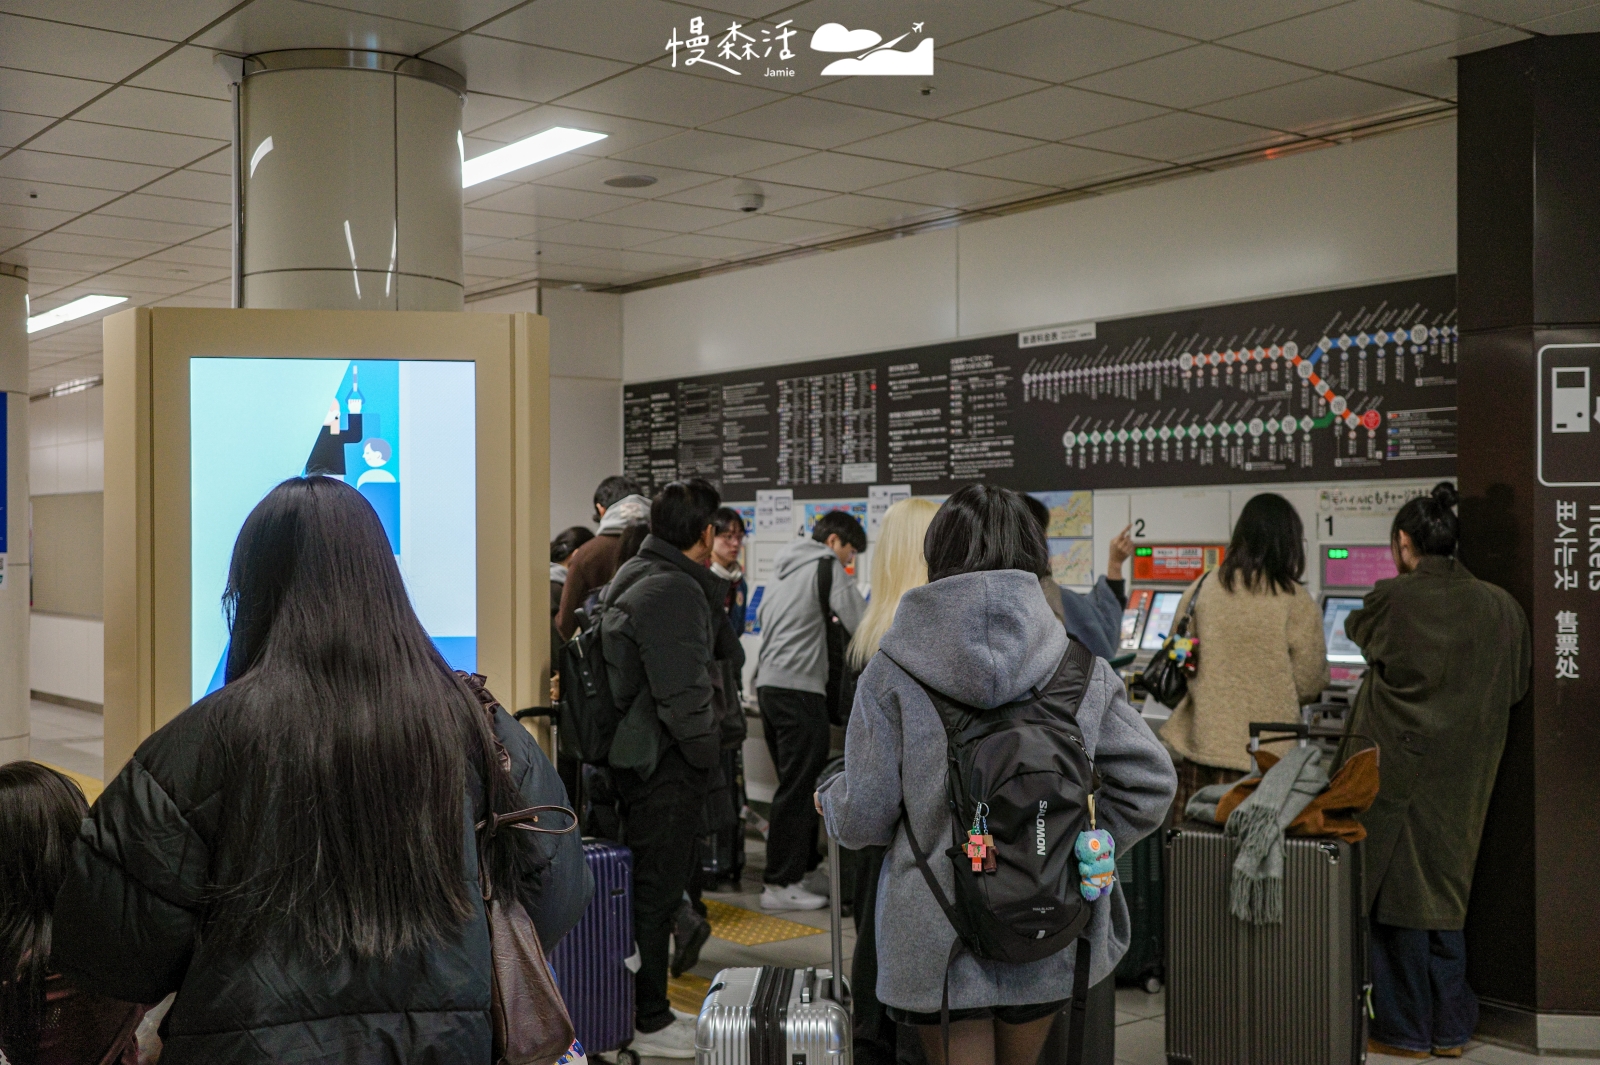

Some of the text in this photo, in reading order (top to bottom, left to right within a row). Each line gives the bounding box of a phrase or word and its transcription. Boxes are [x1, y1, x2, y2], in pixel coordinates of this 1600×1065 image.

[1135, 518, 1146, 538] 2
[1324, 515, 1334, 536] 1
[1554, 499, 1579, 591] 표사는곳
[1554, 609, 1580, 679] 售票处
[1036, 800, 1048, 856] SALOMON
